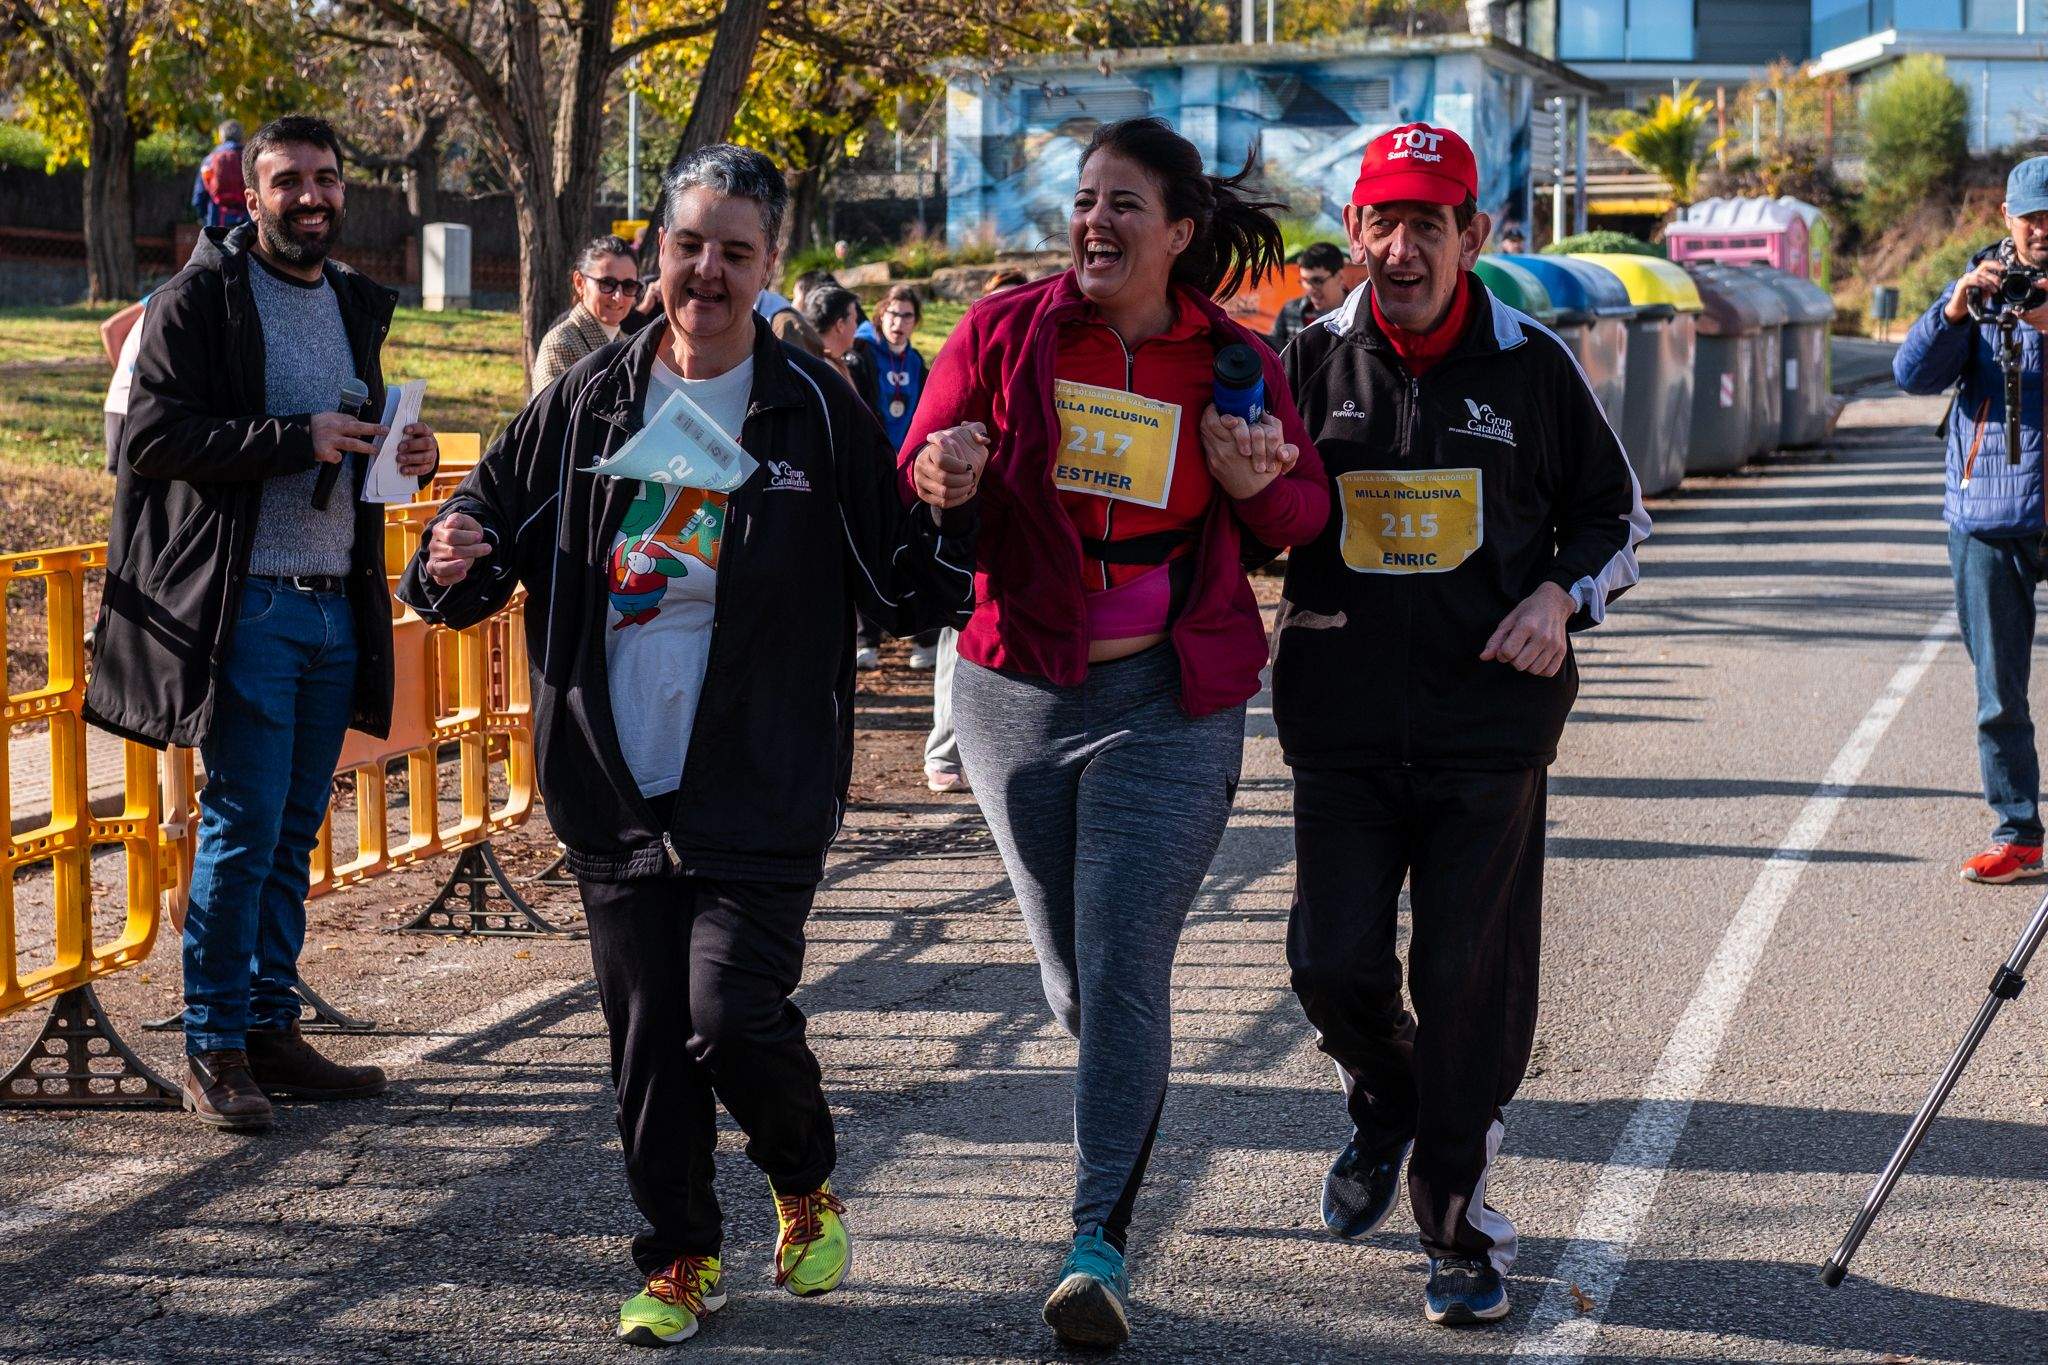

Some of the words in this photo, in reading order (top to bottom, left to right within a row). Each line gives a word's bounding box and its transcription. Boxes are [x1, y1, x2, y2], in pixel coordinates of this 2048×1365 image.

[1393, 129, 1443, 151] TOT
[1387, 149, 1409, 160] Sant
[1412, 150, 1442, 162] Cugat
[1056, 400, 1085, 412] ILLA
[1090, 405, 1159, 428] INCLUSIVA
[1485, 413, 1512, 431] Grup
[1066, 425, 1133, 457] 217
[1056, 465, 1132, 490] ESTHER
[1415, 474, 1425, 482] DE
[1355, 489, 1391, 499] MILLA
[1394, 489, 1462, 500] INCLUSIVA
[1381, 513, 1439, 538] 215
[1382, 552, 1438, 567] ENRIC
